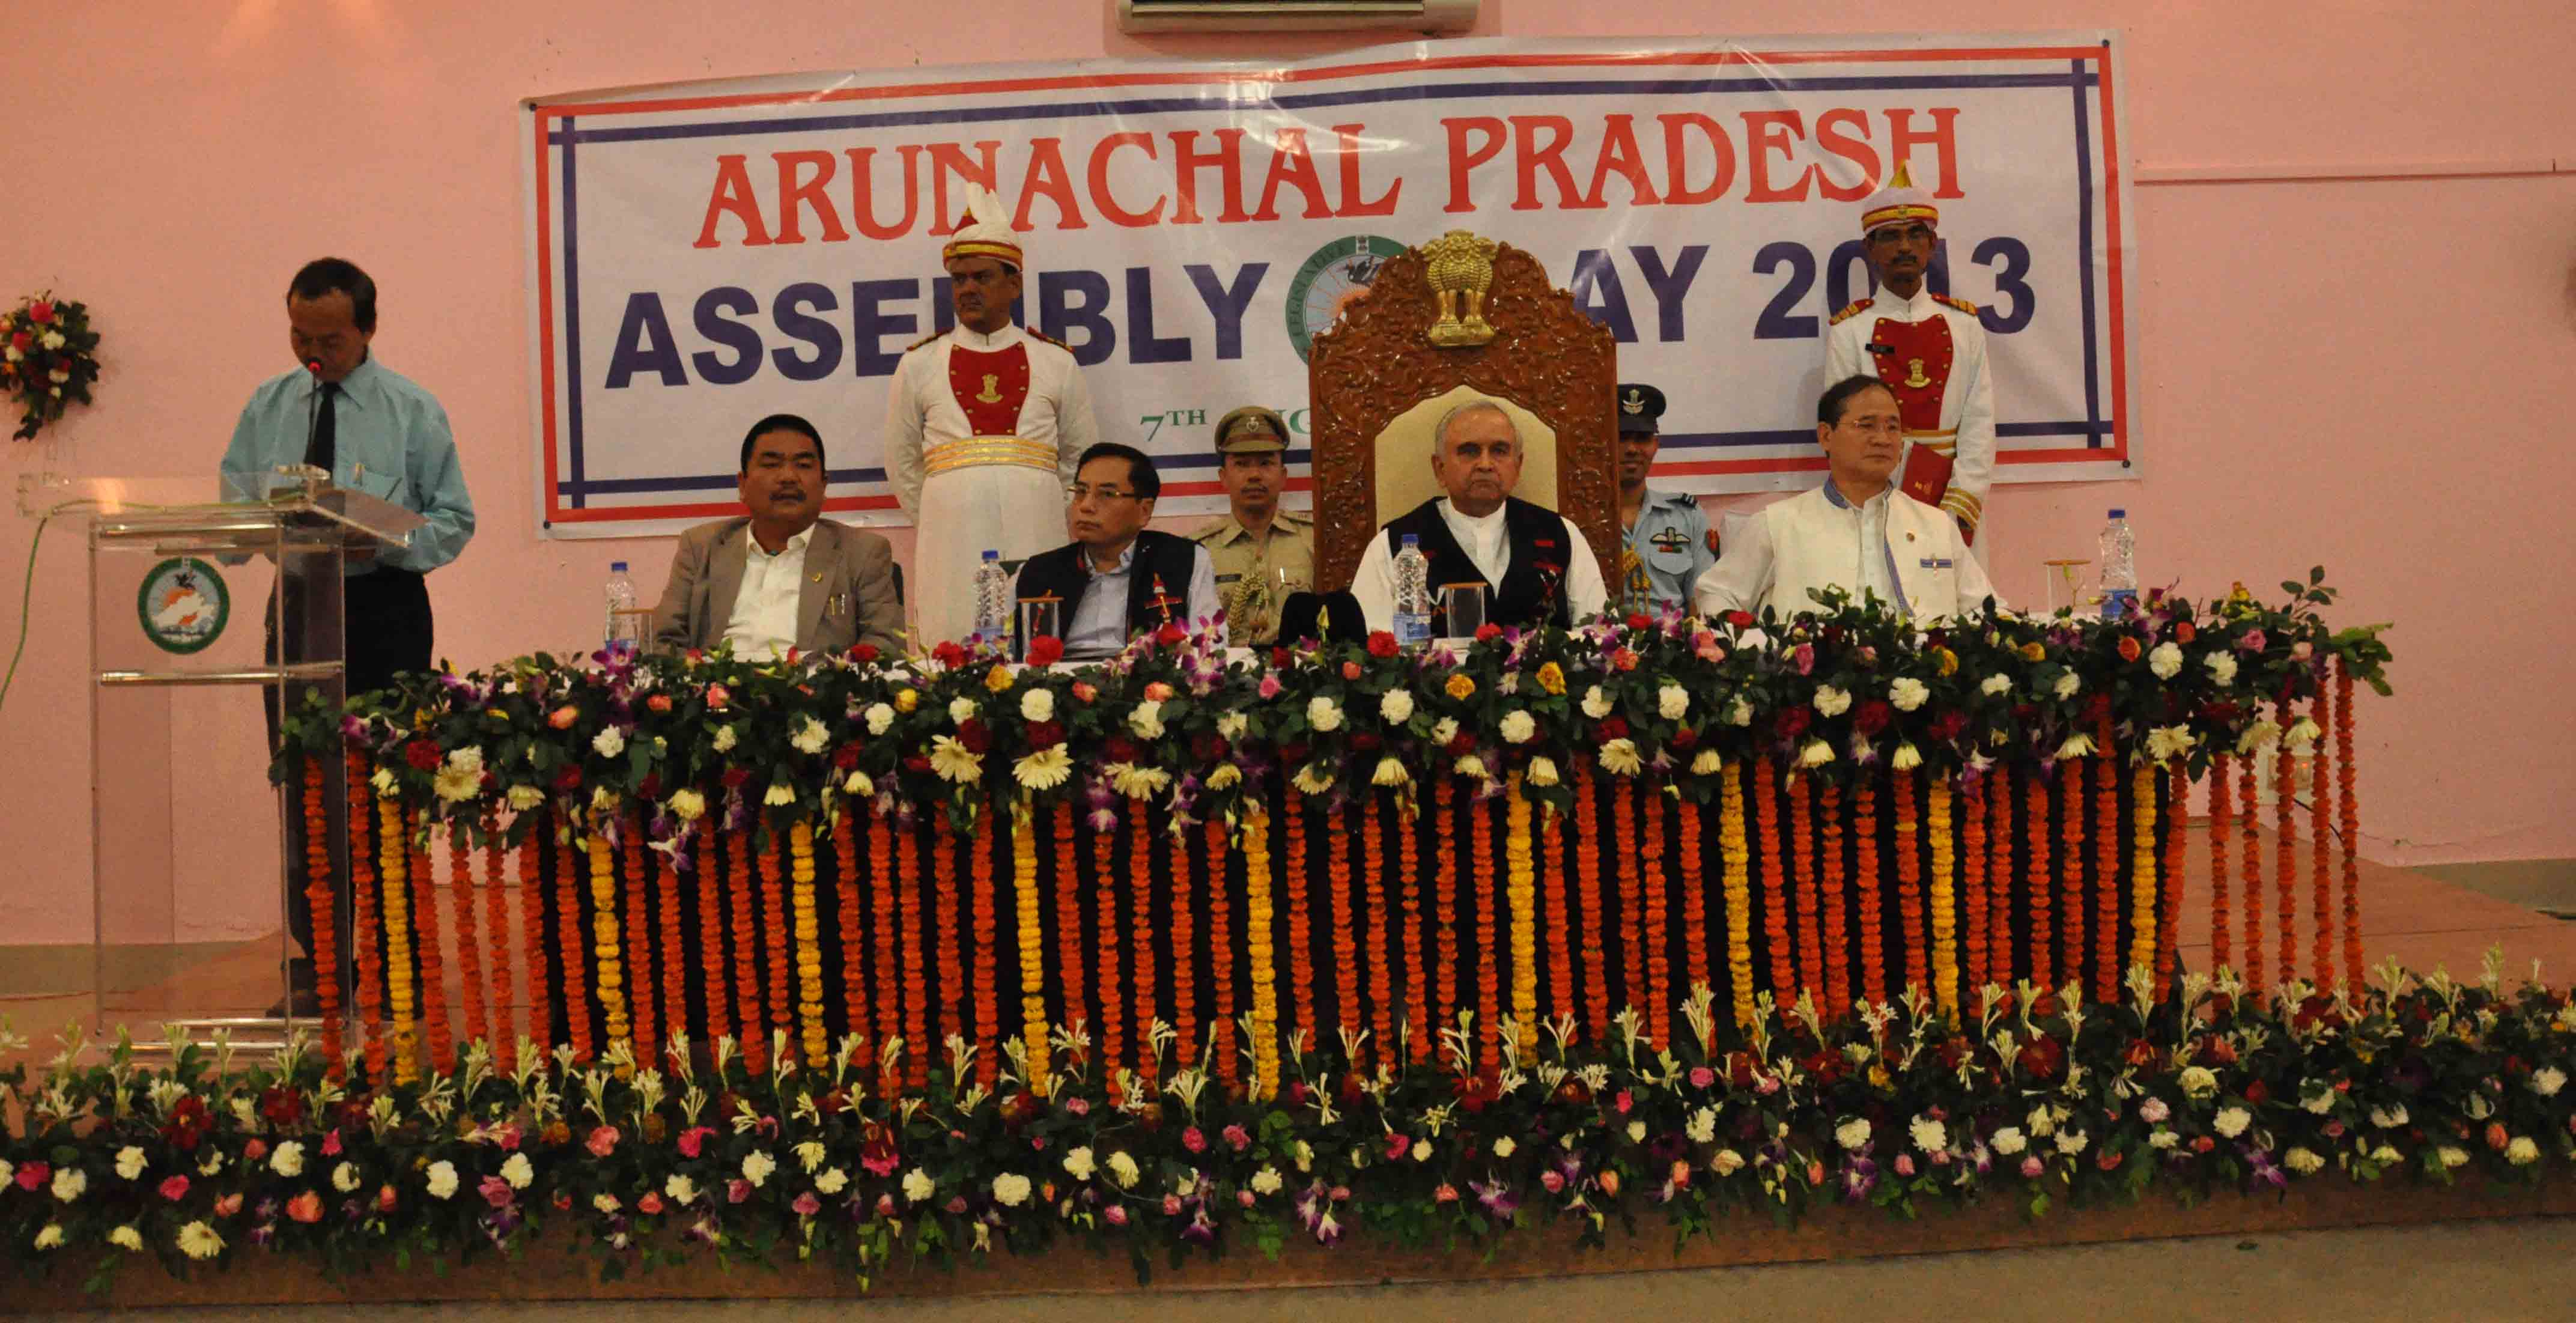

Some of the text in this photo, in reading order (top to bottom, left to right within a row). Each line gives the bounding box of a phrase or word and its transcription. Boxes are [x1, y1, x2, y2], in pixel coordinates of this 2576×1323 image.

[693, 107, 1965, 249] ARUNACHAL PRADESH
[604, 262, 1270, 389] ASSEBLY
[1569, 245, 1710, 343] AY
[1140, 409, 1208, 442] 7TH
